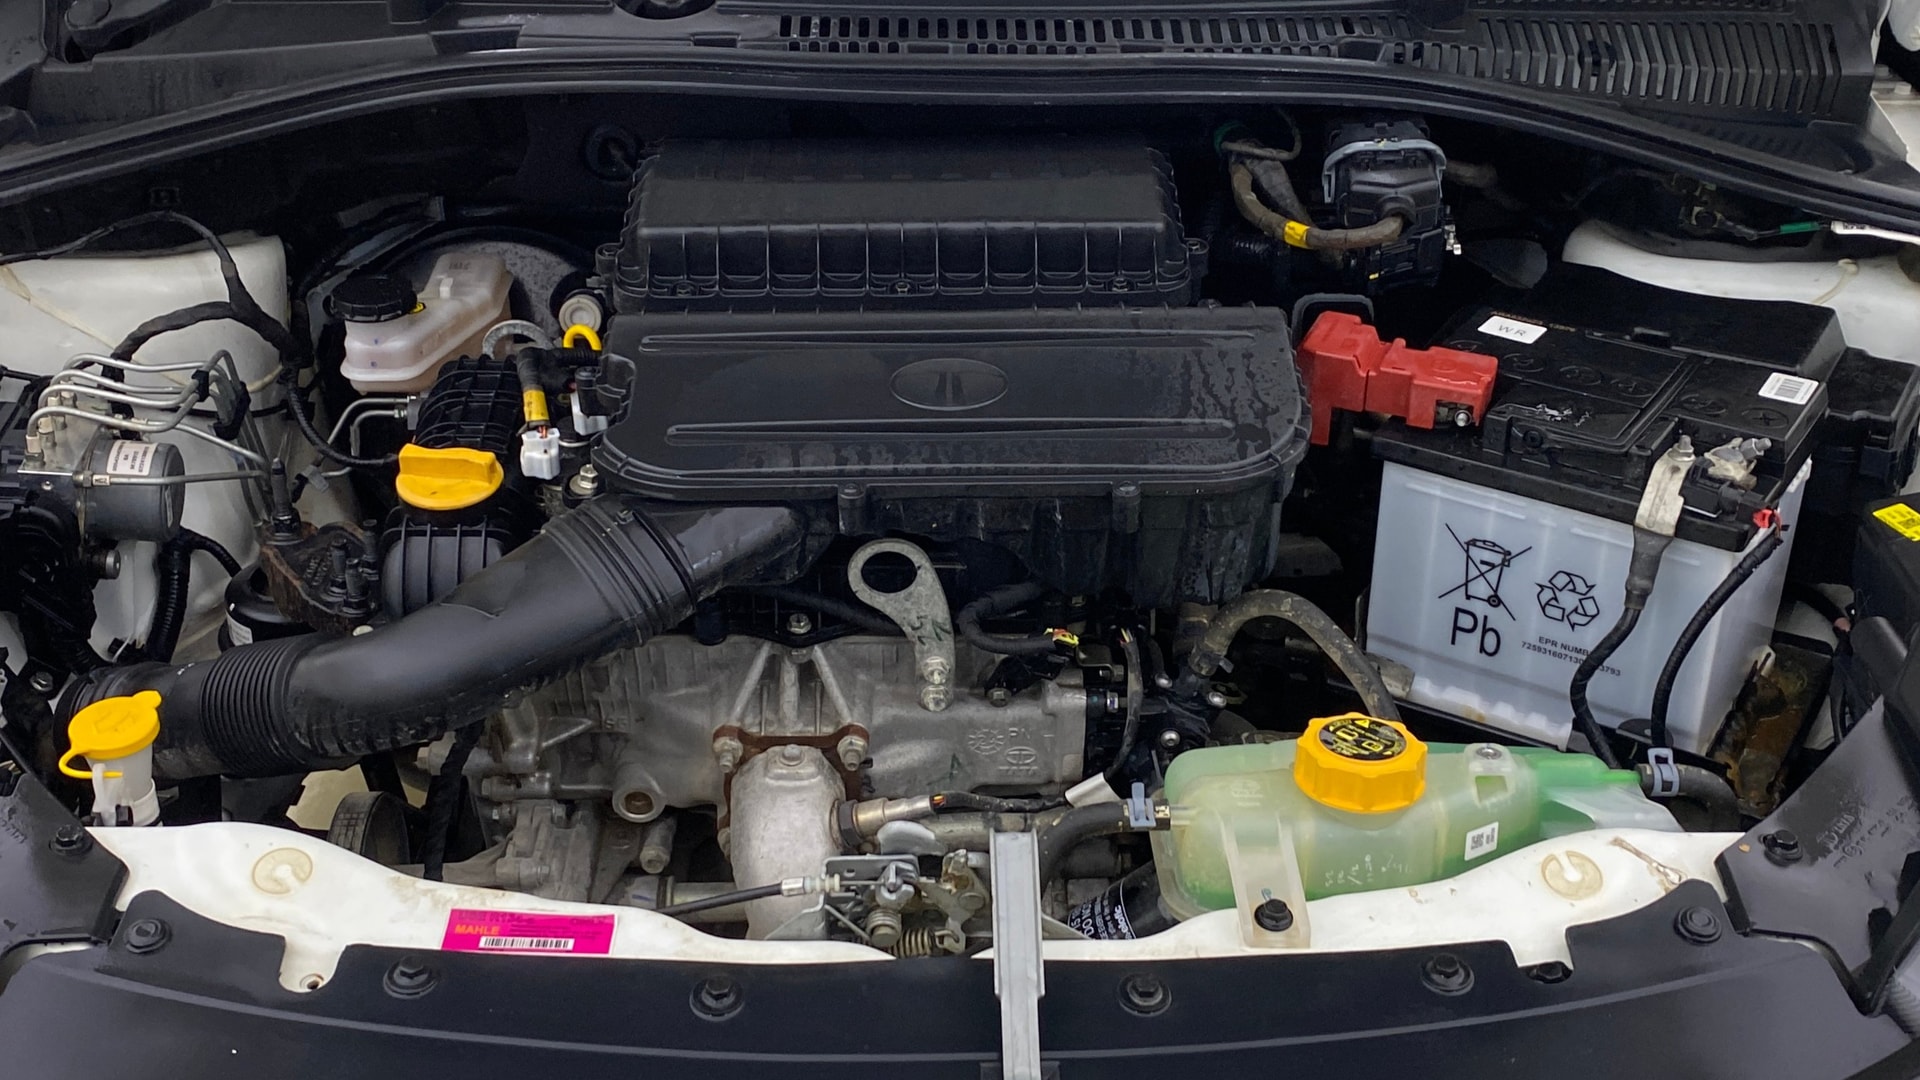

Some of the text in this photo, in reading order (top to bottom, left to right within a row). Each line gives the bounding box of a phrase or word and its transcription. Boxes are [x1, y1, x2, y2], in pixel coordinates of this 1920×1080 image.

[1498, 324, 1527, 337] W R
[1450, 606, 1501, 657] Pb
[1538, 636, 1593, 657] EPR NUMB
[454, 924, 500, 935] MAHLE
